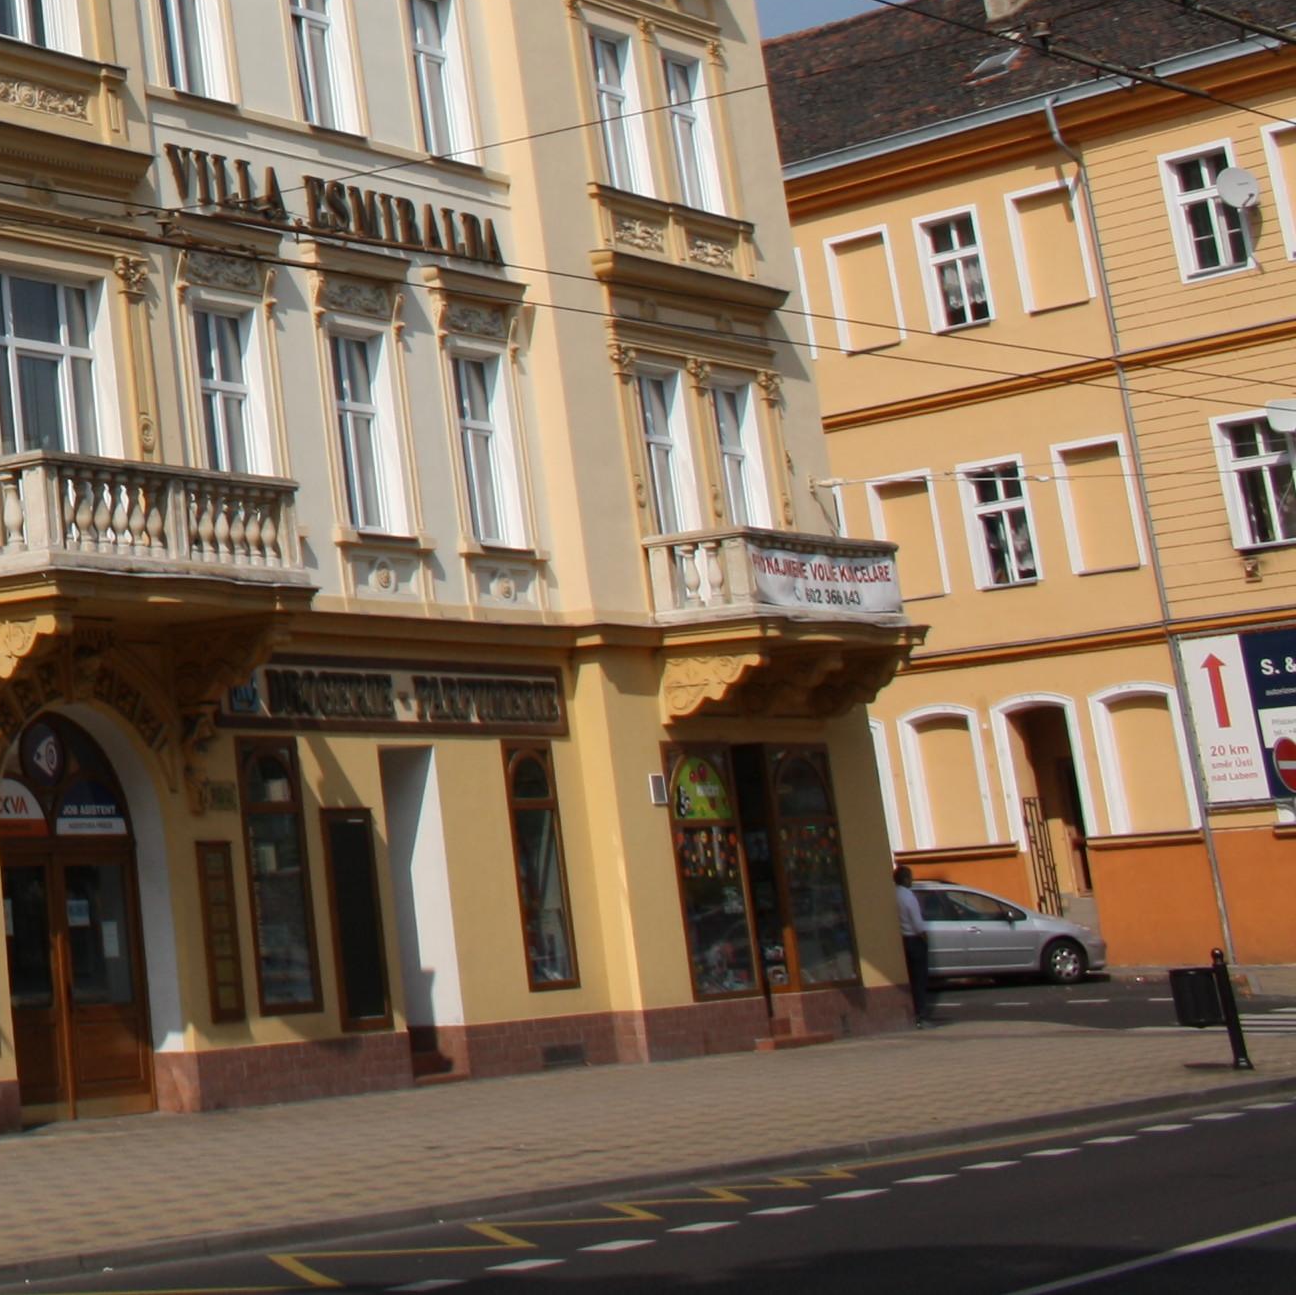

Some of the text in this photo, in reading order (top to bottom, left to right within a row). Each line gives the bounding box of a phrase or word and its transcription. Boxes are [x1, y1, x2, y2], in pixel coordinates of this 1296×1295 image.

[163, 142, 505, 268] VILLA ESMIRALDA
[1260, 657, 1281, 675] S.
[264, 668, 395, 720] DROGERIE
[1210, 744, 1249, 757] 20 km
[1211, 770, 1259, 782] nad Labem
